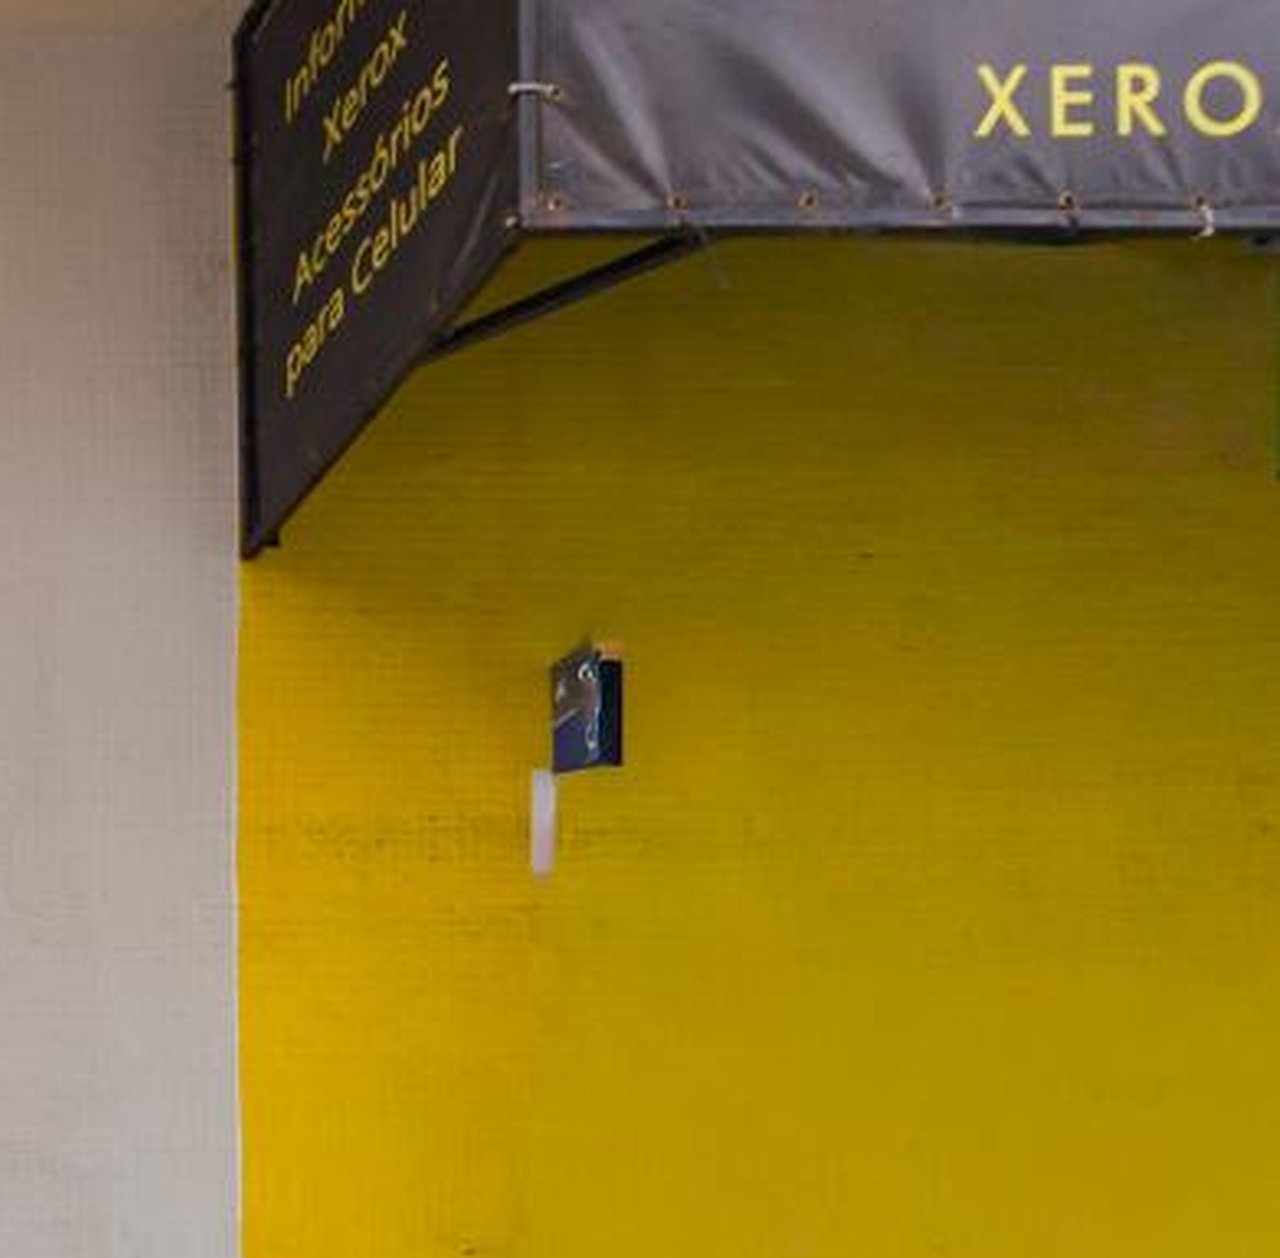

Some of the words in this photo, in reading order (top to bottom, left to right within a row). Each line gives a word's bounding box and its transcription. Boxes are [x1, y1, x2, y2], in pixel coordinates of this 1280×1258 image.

[285, 0, 364, 124] Infor
[322, 9, 407, 164] Xerox
[974, 60, 1261, 136] XERO
[293, 57, 449, 305] Acessórios
[286, 287, 344, 399] para
[352, 125, 463, 294] Celular
